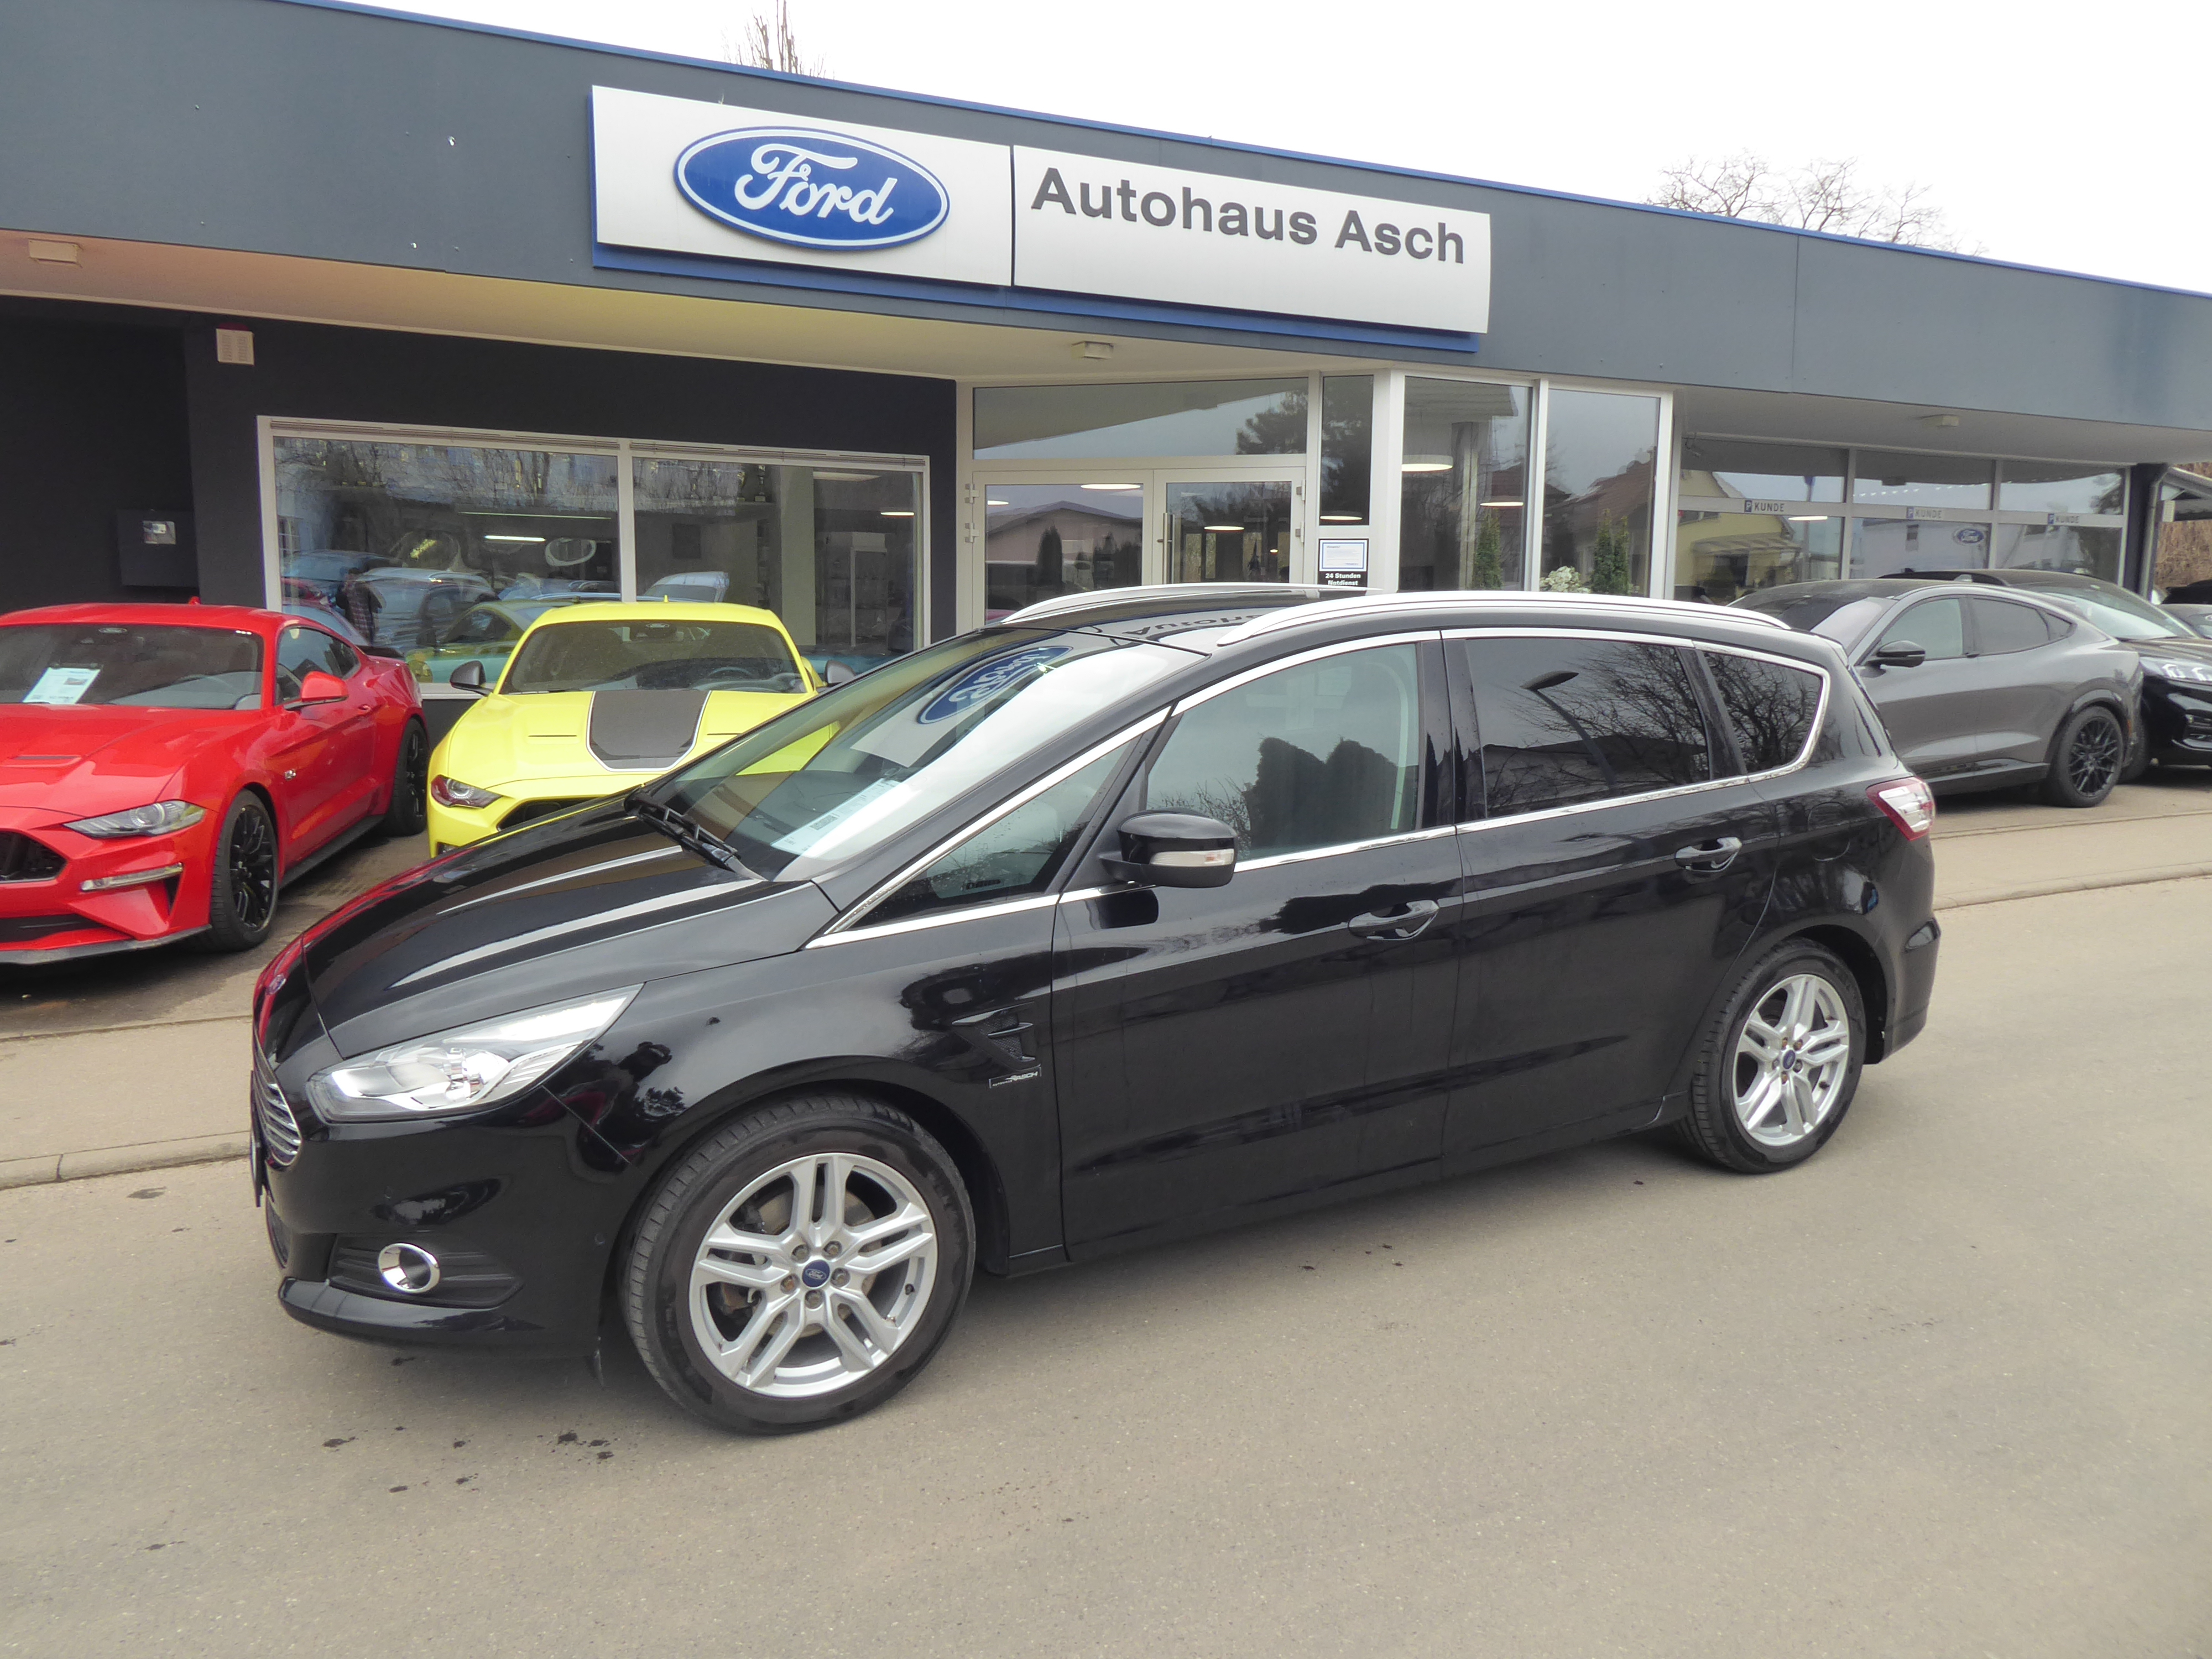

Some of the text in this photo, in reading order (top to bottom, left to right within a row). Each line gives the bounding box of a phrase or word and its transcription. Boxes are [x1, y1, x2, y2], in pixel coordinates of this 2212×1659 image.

[735, 143, 898, 225] Ford
[1031, 168, 1464, 264] Autohaus Asch
[1754, 502, 1785, 512] KUNDE
[1915, 509, 1942, 519] KUNDE
